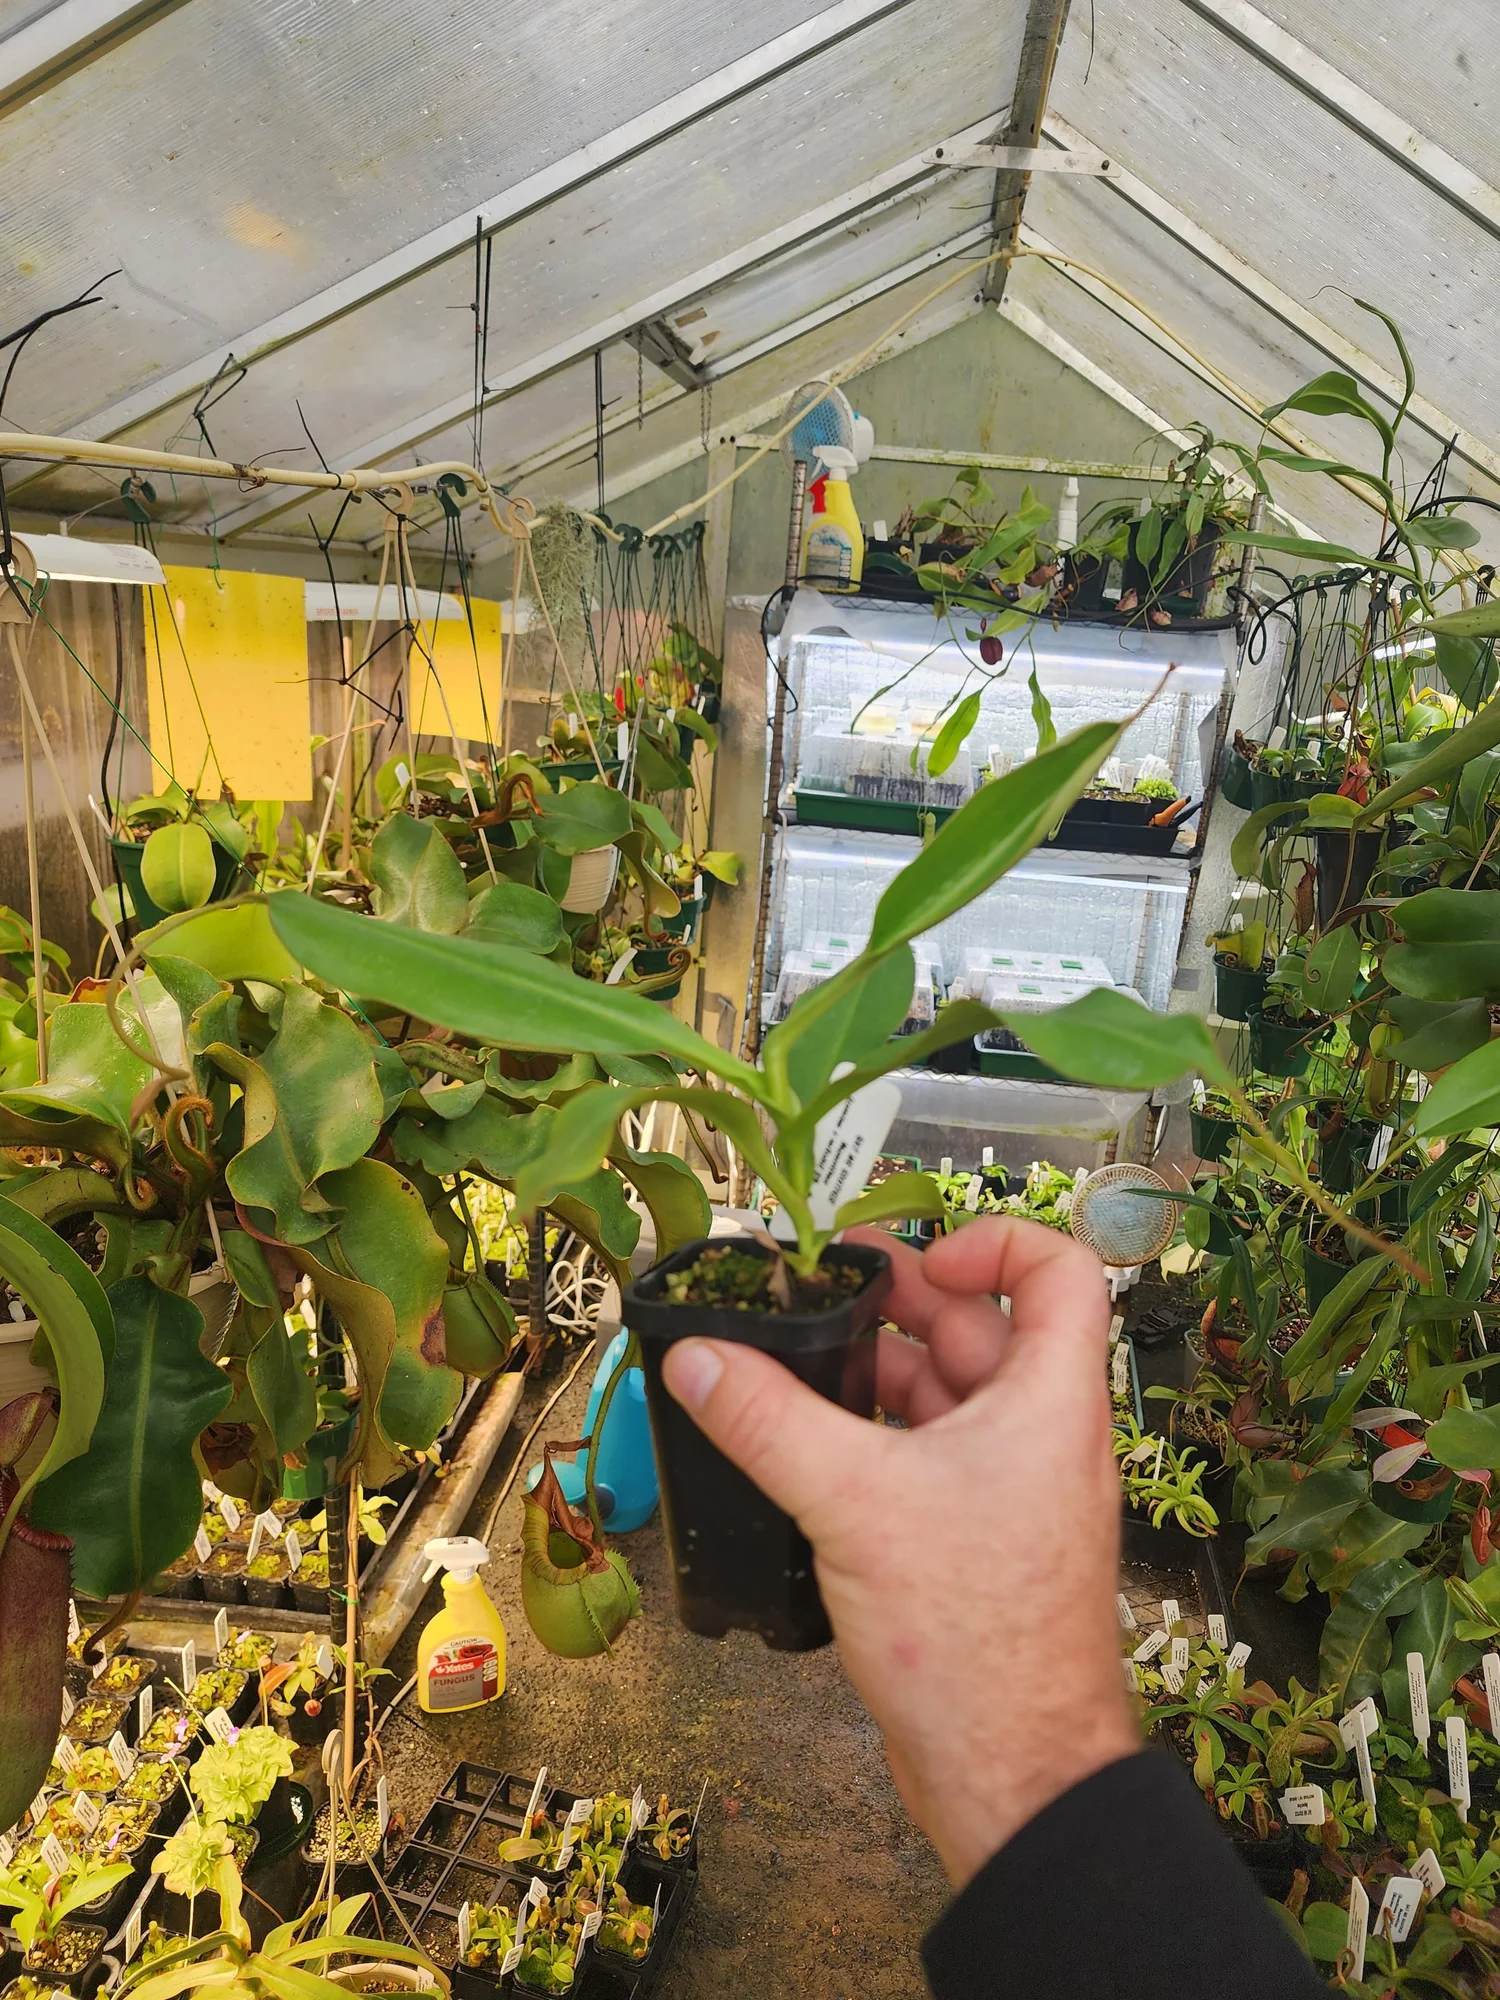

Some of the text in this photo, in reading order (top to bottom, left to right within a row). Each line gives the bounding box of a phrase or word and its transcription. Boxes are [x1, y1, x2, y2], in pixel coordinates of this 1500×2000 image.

[450, 1638, 477, 1647] CAUTION
[444, 1662, 475, 1673] Yates
[434, 1674, 475, 1686] FUNGUS
